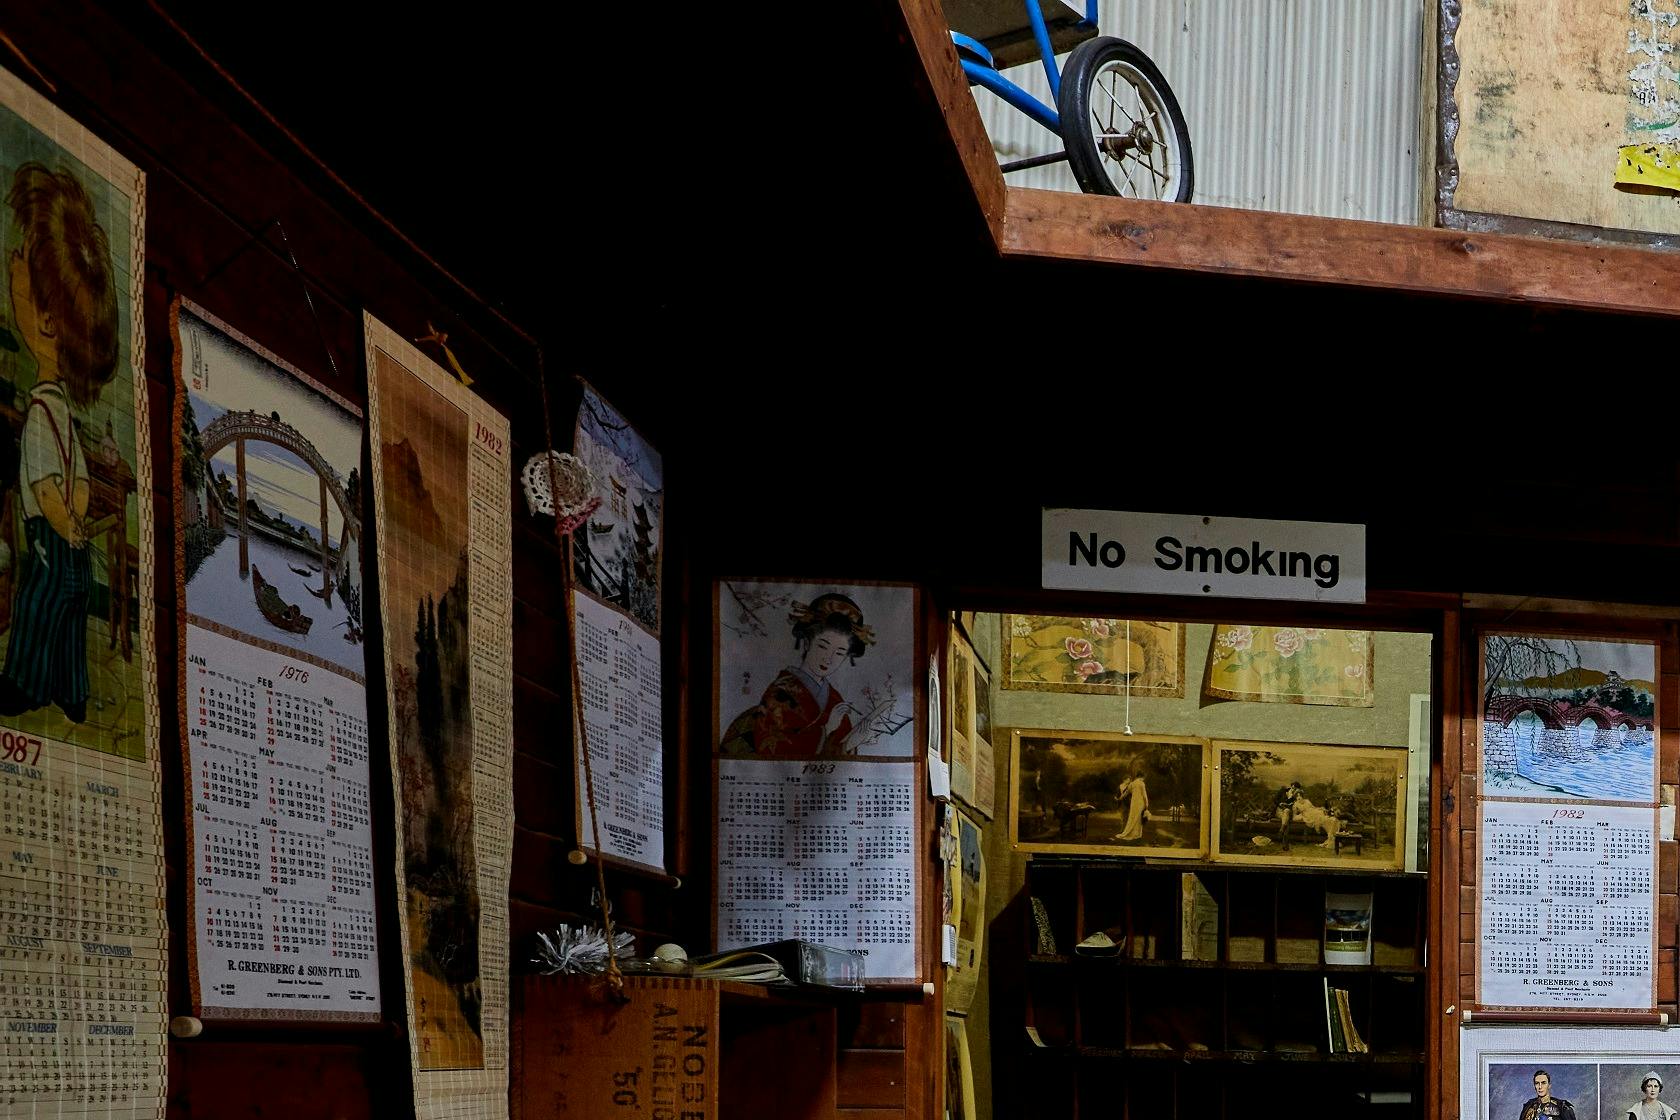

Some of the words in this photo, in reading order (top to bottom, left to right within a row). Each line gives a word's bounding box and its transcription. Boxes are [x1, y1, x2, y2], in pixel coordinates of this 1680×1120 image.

[475, 421, 503, 456] 1982
[1069, 531, 1126, 568] No
[1154, 536, 1340, 589] Smoking
[189, 654, 206, 666] JAN
[278, 665, 309, 684] 1976
[257, 676, 273, 688] FEB
[323, 696, 333, 706] MAR
[191, 728, 207, 740] APR
[0, 731, 42, 766] 987
[259, 747, 275, 757] MAY
[802, 763, 836, 774] 1983
[86, 781, 119, 798] MARCH
[196, 804, 210, 814] JUL
[1552, 809, 1585, 819] 1982
[261, 818, 277, 827] AUG
[12, 850, 34, 864] MAY
[96, 864, 120, 878] JUNE
[198, 877, 212, 887] OCT
[263, 887, 278, 896] NOV
[6, 934, 45, 948] AUGUST
[82, 943, 133, 957] SEPTEMBER
[228, 960, 237, 971] R.
[238, 960, 294, 975] GREENBERG
[298, 965, 304, 976] &
[308, 965, 328, 976] SONS
[345, 968, 362, 979] LTD.
[7, 1021, 57, 1034] NOVEMBER
[88, 1023, 134, 1036] DECEMBER
